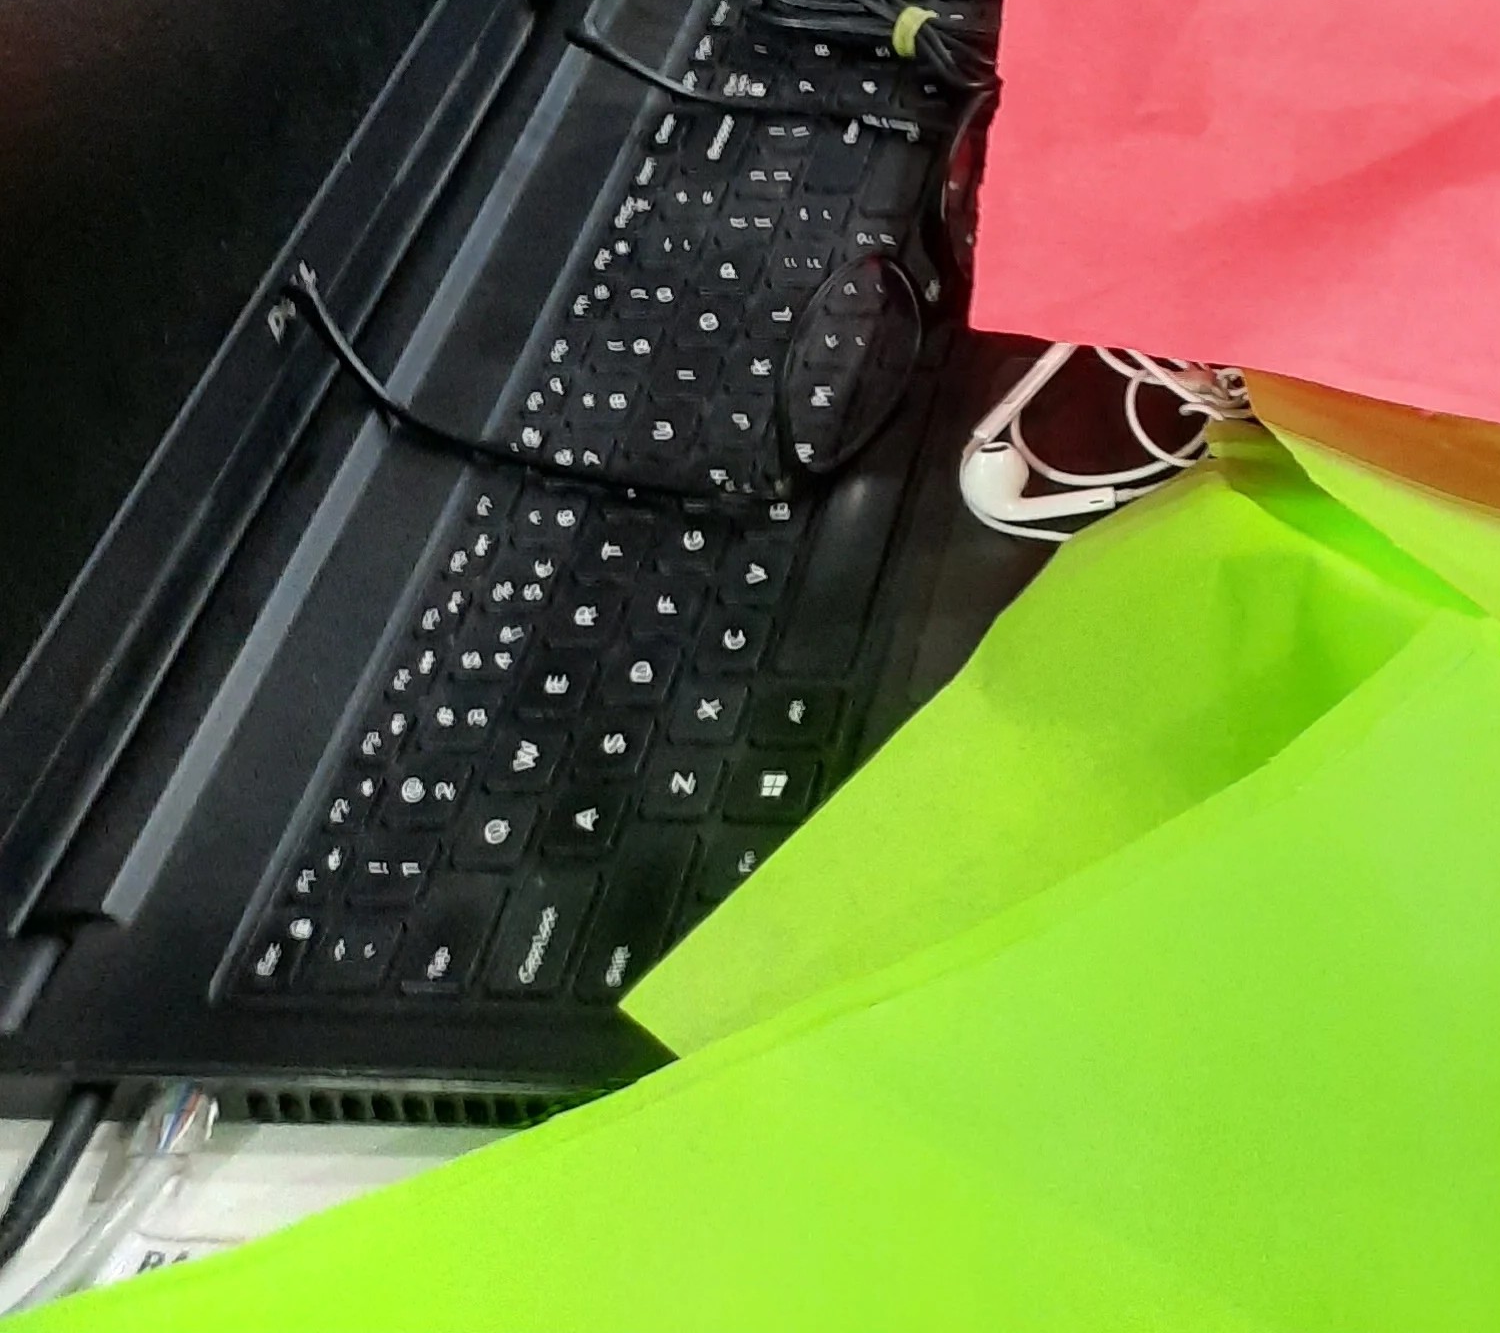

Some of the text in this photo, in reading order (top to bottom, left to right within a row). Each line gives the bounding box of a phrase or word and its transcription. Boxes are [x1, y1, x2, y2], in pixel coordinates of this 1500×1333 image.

[772, 305, 794, 323] L
[751, 358, 774, 377] K
[811, 385, 836, 408] M
[601, 541, 625, 562] T
[683, 530, 706, 552] G
[746, 562, 770, 586] V
[574, 605, 600, 627] R
[657, 595, 679, 615] F
[723, 628, 748, 652] C
[630, 660, 655, 684] D
[544, 673, 571, 695] E
[697, 698, 724, 722] X
[601, 732, 628, 756] S
[513, 740, 541, 773] W
[435, 781, 458, 802] 2
[669, 771, 698, 796] Z
[575, 807, 601, 833] A
[484, 818, 512, 846] Q
